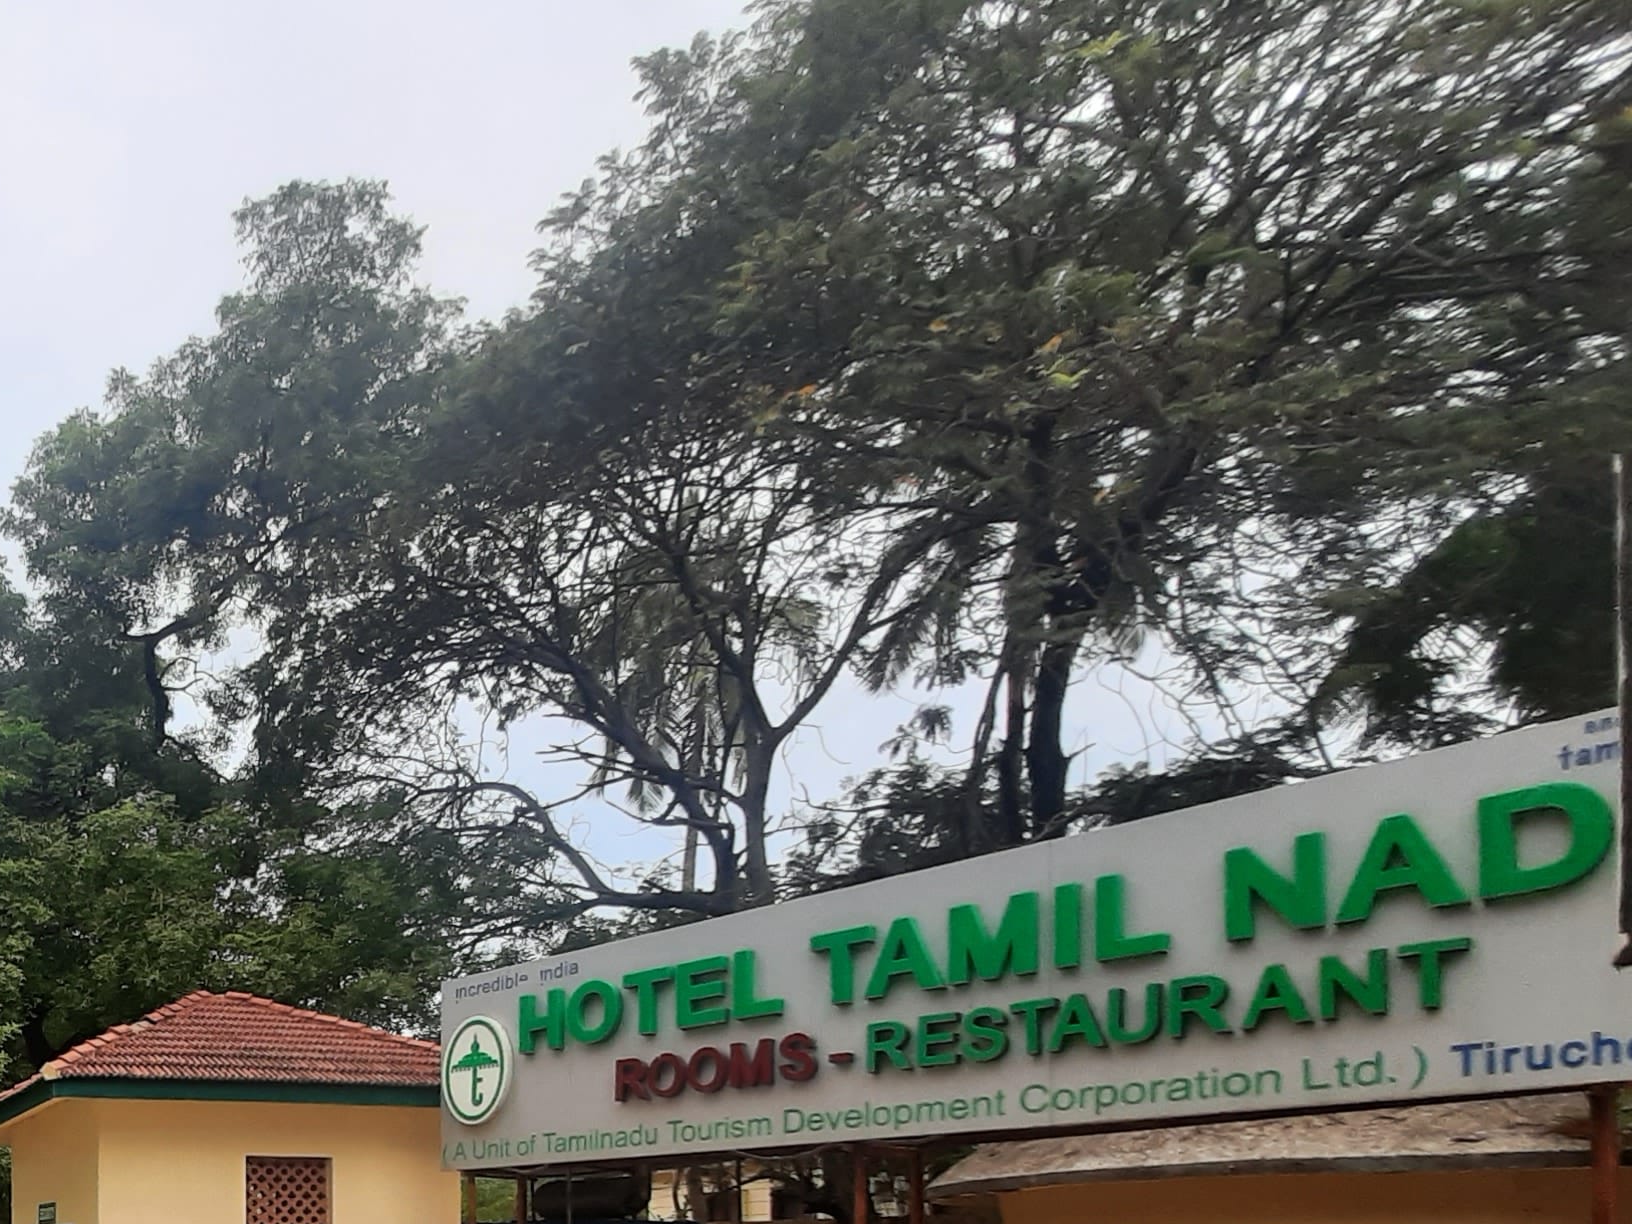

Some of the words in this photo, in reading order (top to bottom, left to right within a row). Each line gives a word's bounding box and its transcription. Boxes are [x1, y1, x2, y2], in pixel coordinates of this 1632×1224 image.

[518, 948, 785, 1055] HOTEL
[810, 873, 1171, 1006] TAMIL
[1224, 781, 1615, 942] NAD
[472, 1138, 512, 1161] Unit
[517, 1134, 537, 1157] of
[542, 1124, 658, 1153] Tamilnadu
[668, 1115, 773, 1144] Tourism
[783, 1089, 1006, 1134] Development
[1019, 1066, 1282, 1115] Corporation
[1449, 1030, 1632, 1077] Tiruch
[614, 1032, 818, 1103] ROOMS
[865, 936, 1473, 1075] RESTAURANT
